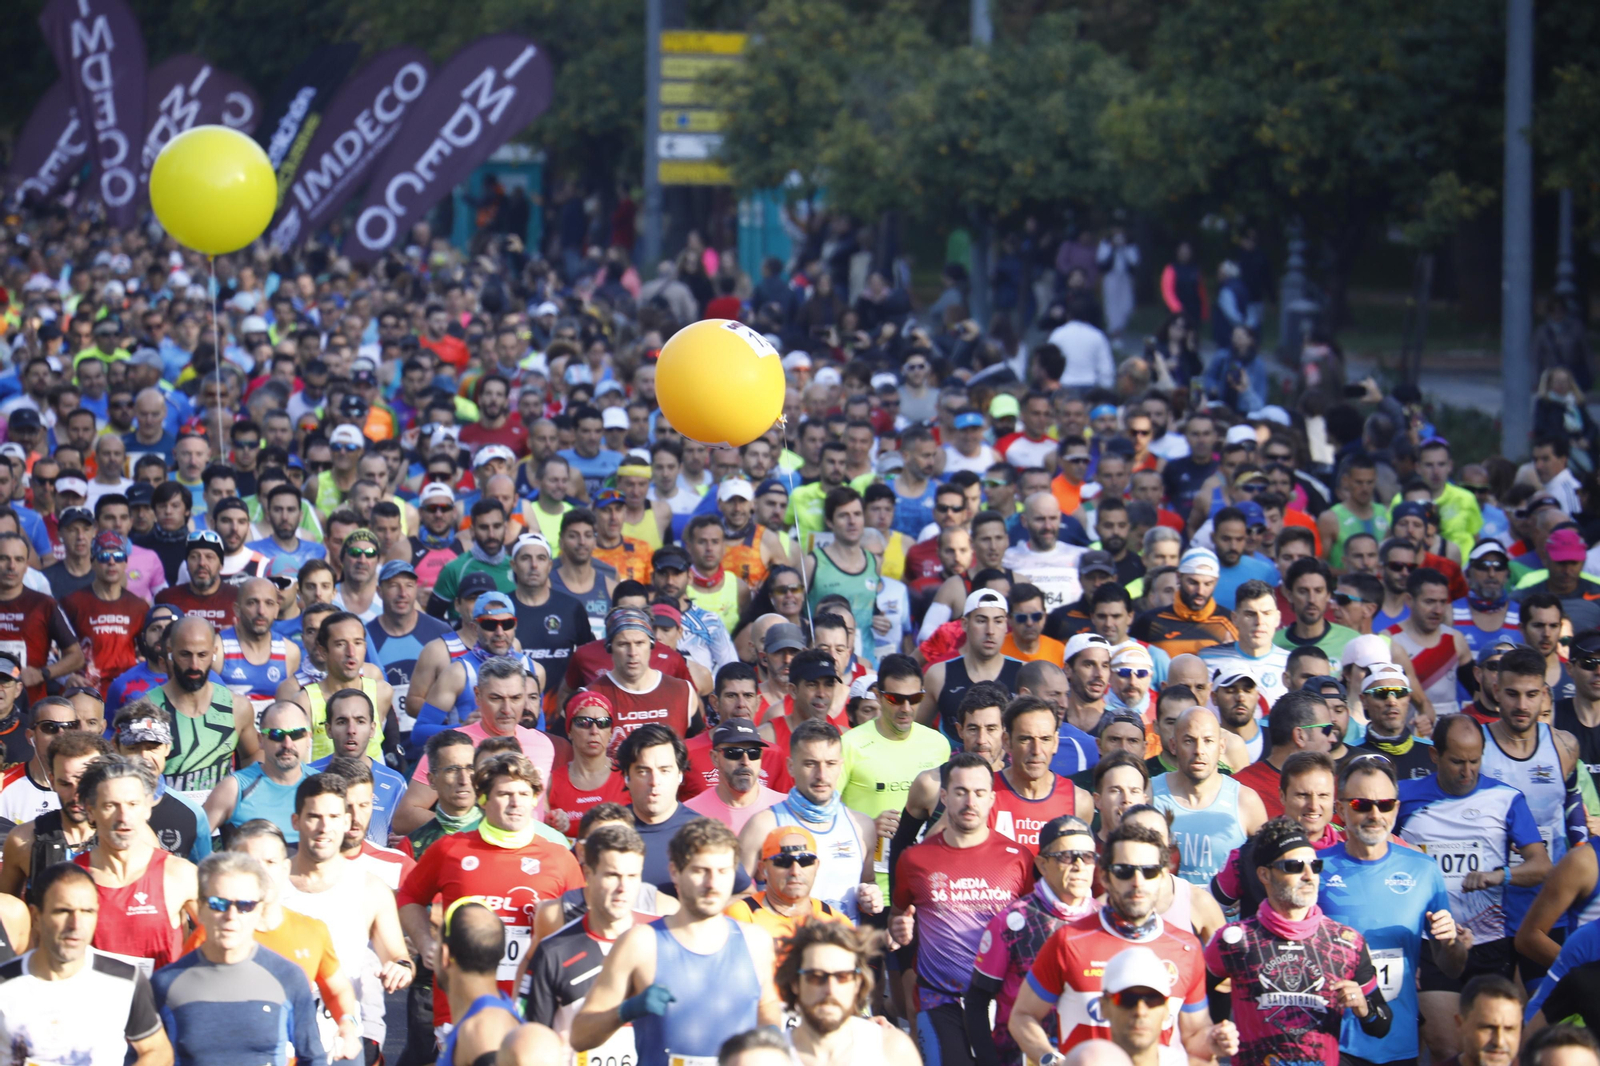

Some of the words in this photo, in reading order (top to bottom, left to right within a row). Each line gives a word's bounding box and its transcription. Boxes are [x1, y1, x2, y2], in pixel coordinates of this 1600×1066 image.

[293, 62, 428, 210] IMDECO
[356, 45, 535, 250] IMDECO
[89, 614, 130, 625] LOBOS
[93, 625, 128, 635] TRAIL
[521, 648, 570, 659] TIBLES
[617, 708, 668, 721] LOBOS
[1433, 853, 1479, 874] 070
[949, 877, 989, 890] MEDIA
[931, 889, 948, 902] 36
[950, 885, 1011, 901] MARATÓN
[471, 895, 519, 912] BL
[1302, 956, 1322, 977] TEAM
